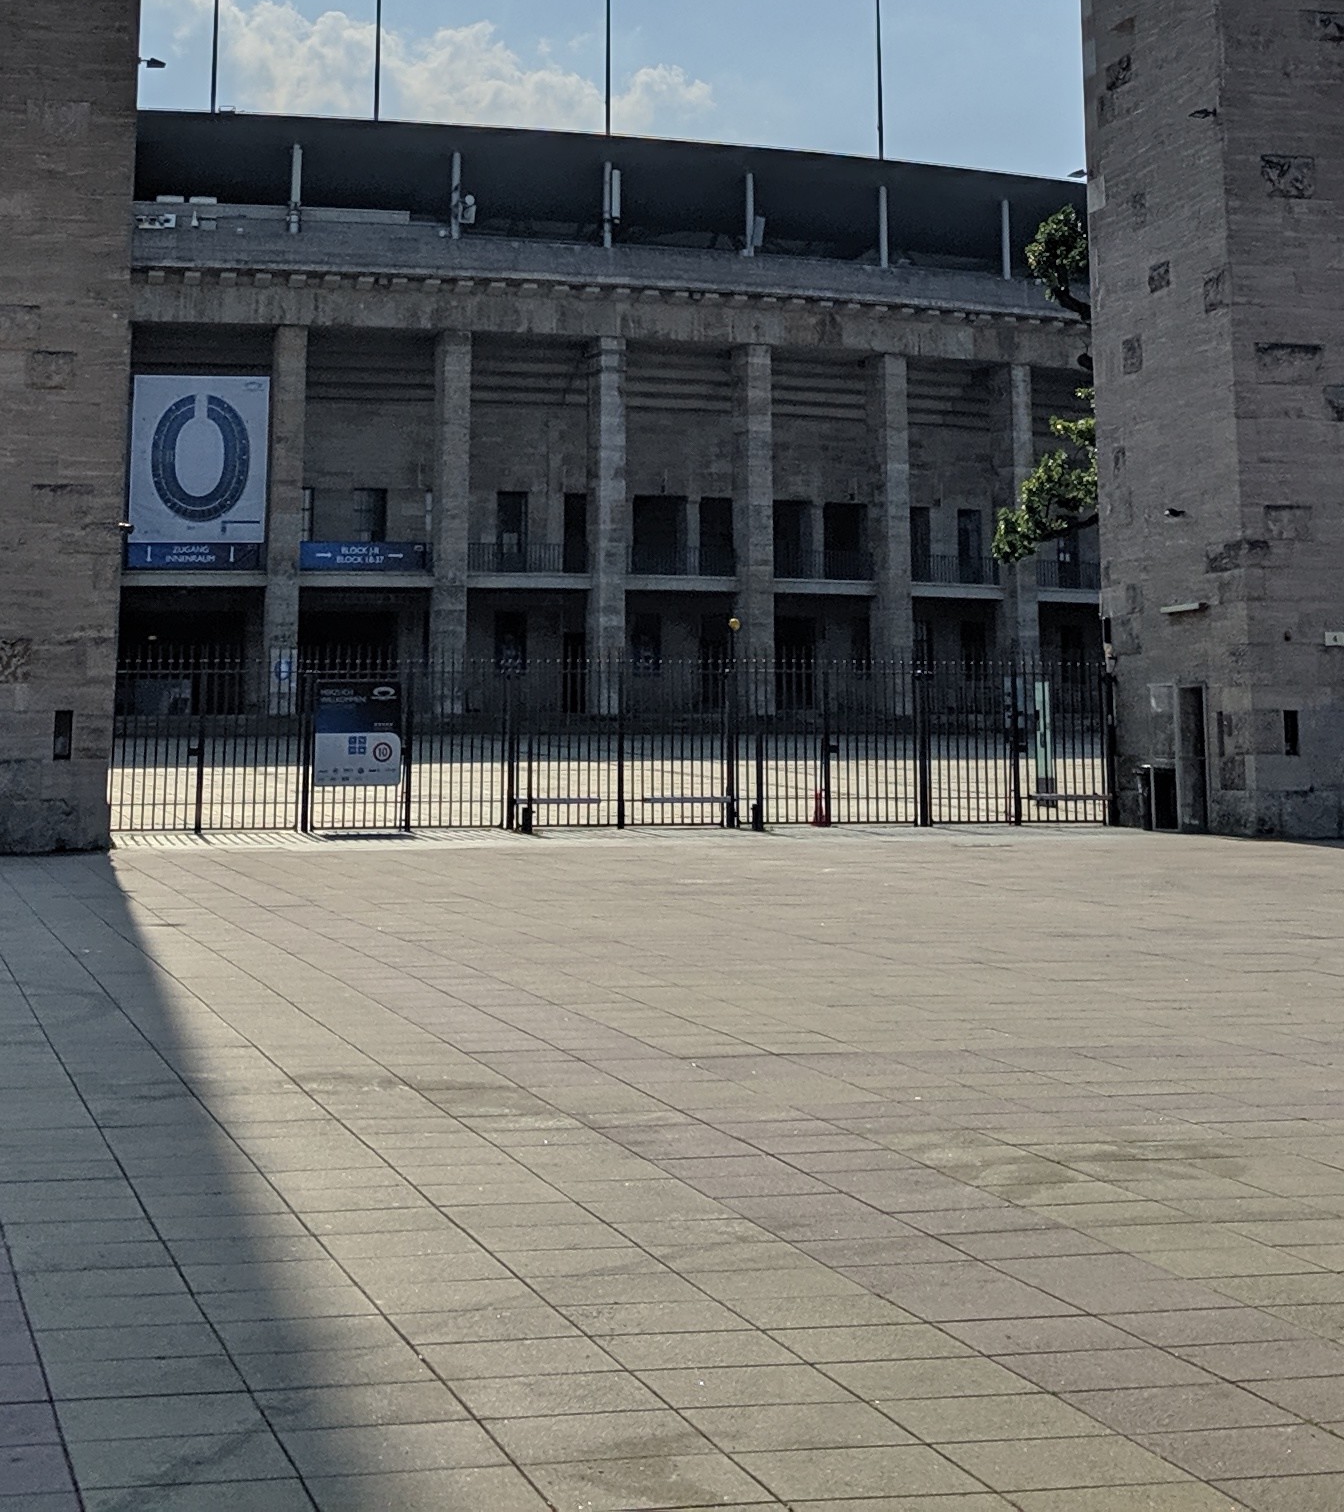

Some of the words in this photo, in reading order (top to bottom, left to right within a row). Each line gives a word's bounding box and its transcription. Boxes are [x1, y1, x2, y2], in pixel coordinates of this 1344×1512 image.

[172, 545, 210, 554] ZUGANG
[340, 546, 368, 555] BLOCK
[165, 554, 216, 563] INNENRAUM
[336, 555, 363, 564] BLOCK
[378, 747, 388, 758] 10
